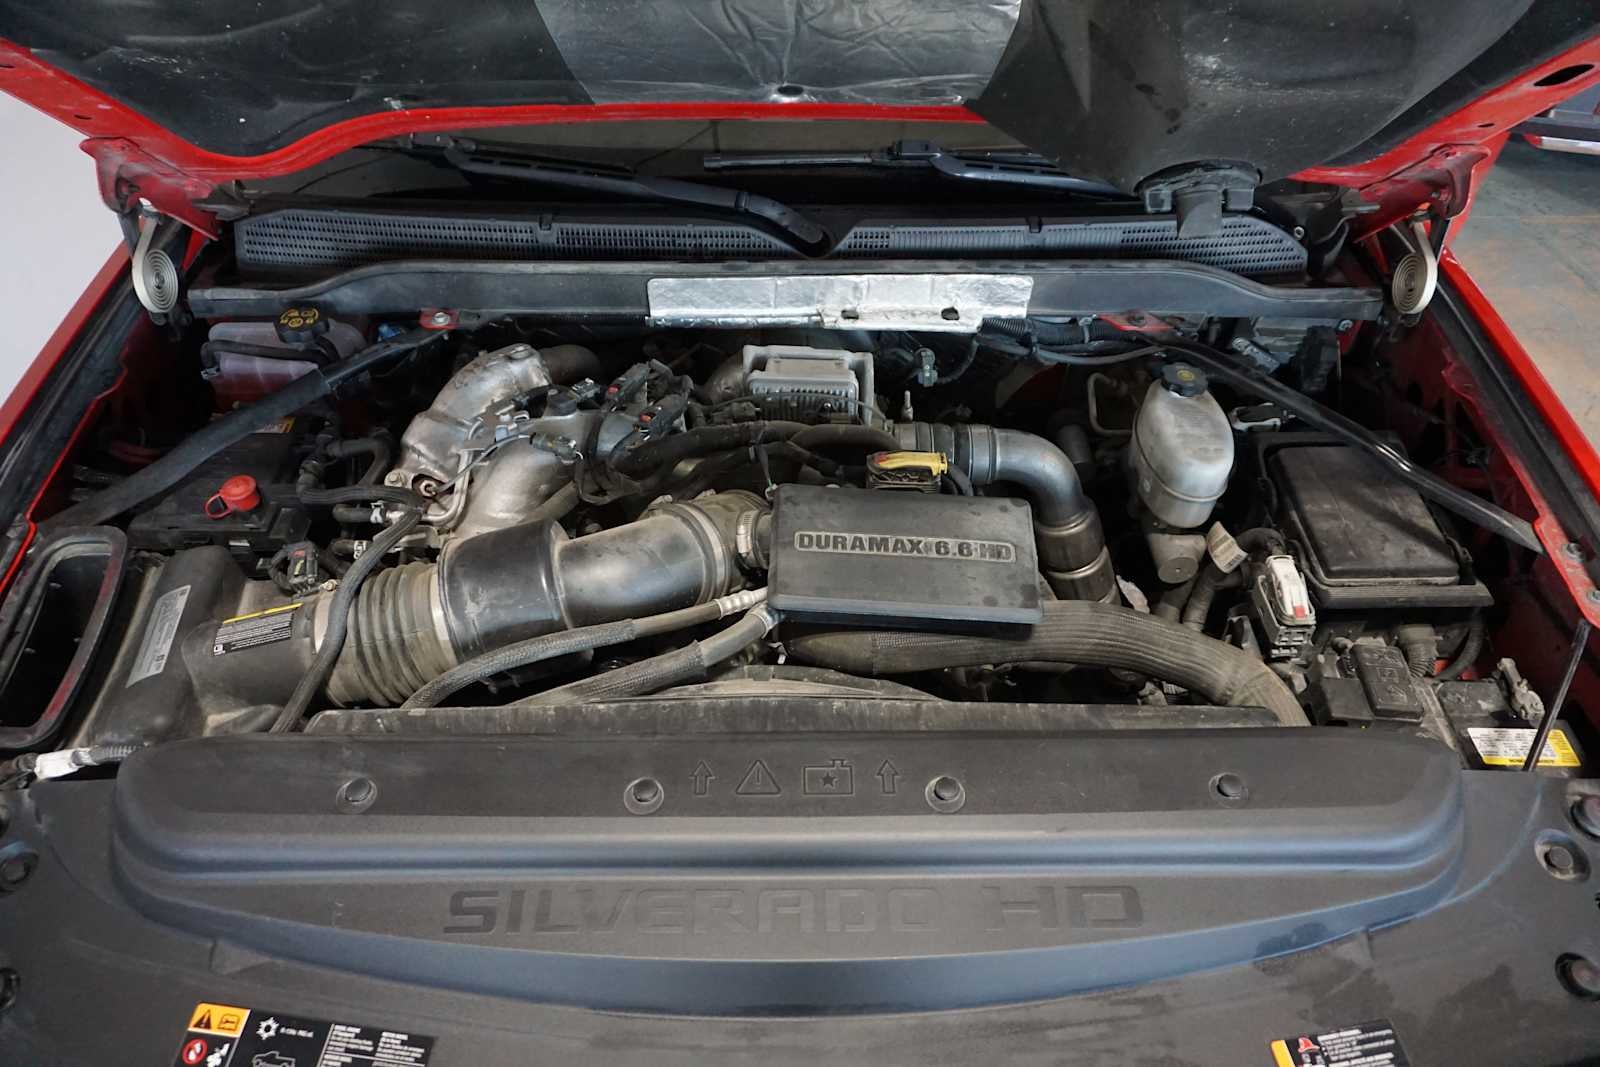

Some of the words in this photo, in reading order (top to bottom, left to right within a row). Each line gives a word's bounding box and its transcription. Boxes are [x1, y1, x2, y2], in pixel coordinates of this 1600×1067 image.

[799, 533, 925, 555] DURAMAX
[934, 540, 974, 558] 6.6
[979, 542, 1012, 561] HD
[442, 886, 941, 934] SILVERADO
[980, 884, 1143, 931] HD
